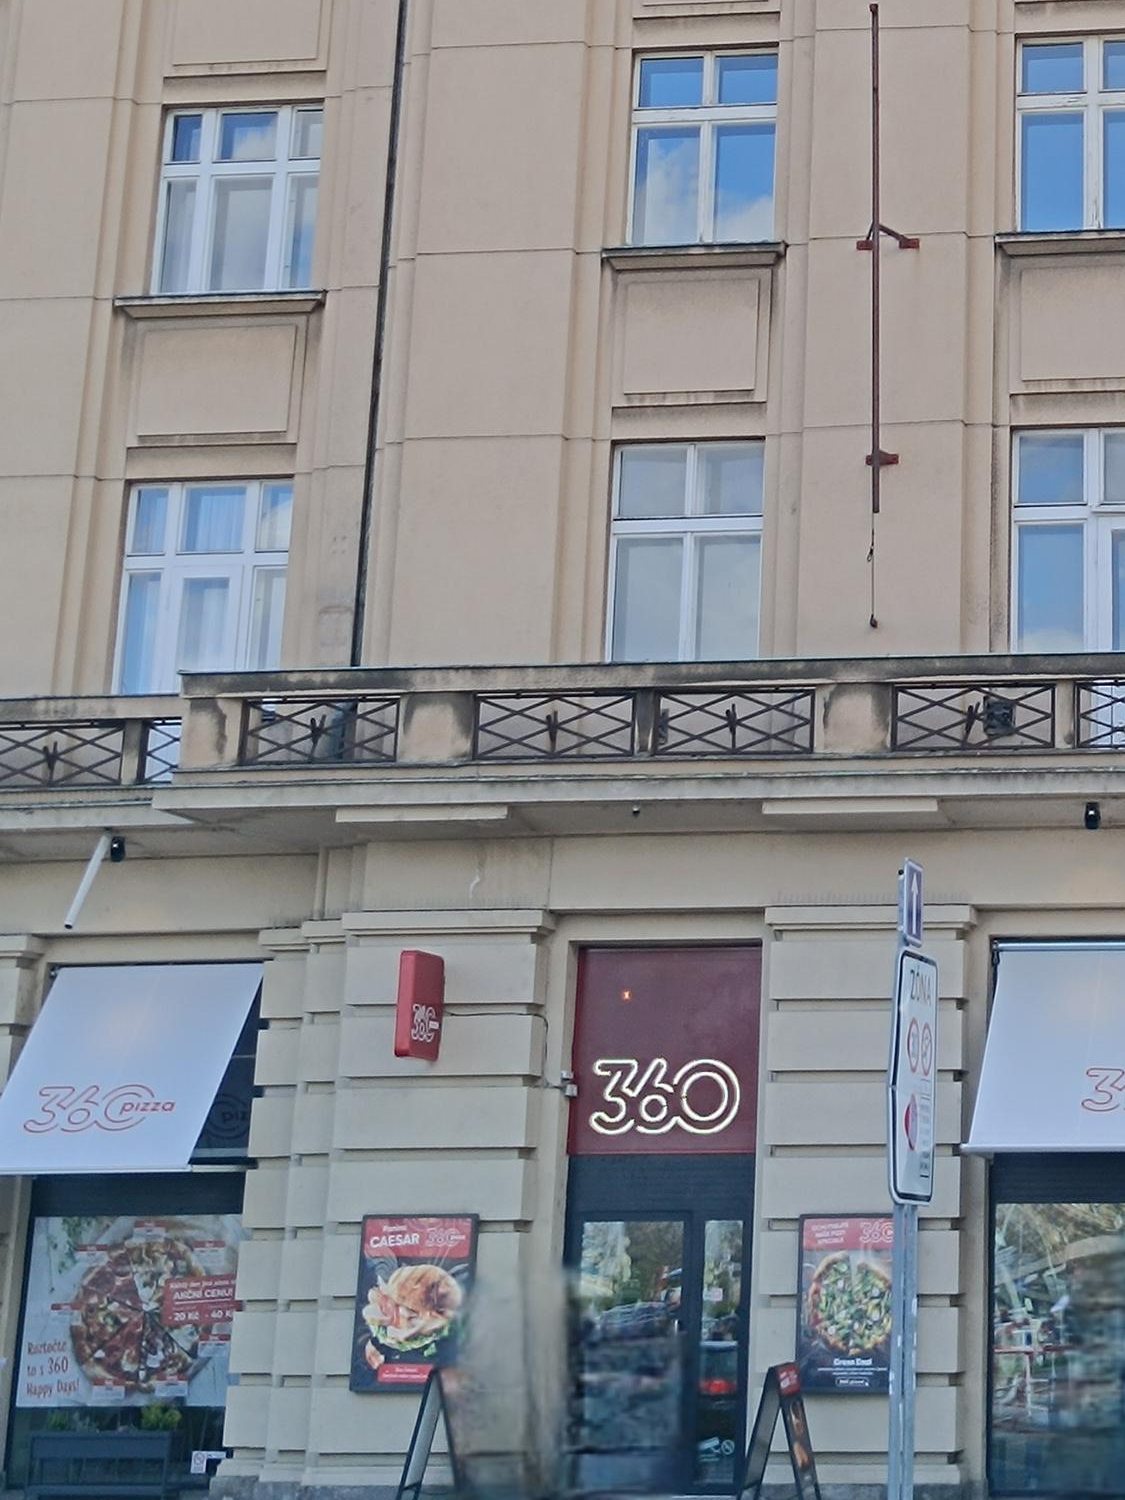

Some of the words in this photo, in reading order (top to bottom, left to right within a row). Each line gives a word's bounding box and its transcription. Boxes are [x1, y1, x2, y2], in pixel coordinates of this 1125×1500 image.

[23, 1084, 155, 1134] 360
[119, 1099, 176, 1116] pizza
[588, 1057, 741, 1135] 360
[369, 1232, 420, 1249] CAESAR
[47, 1355, 69, 1375] 360
